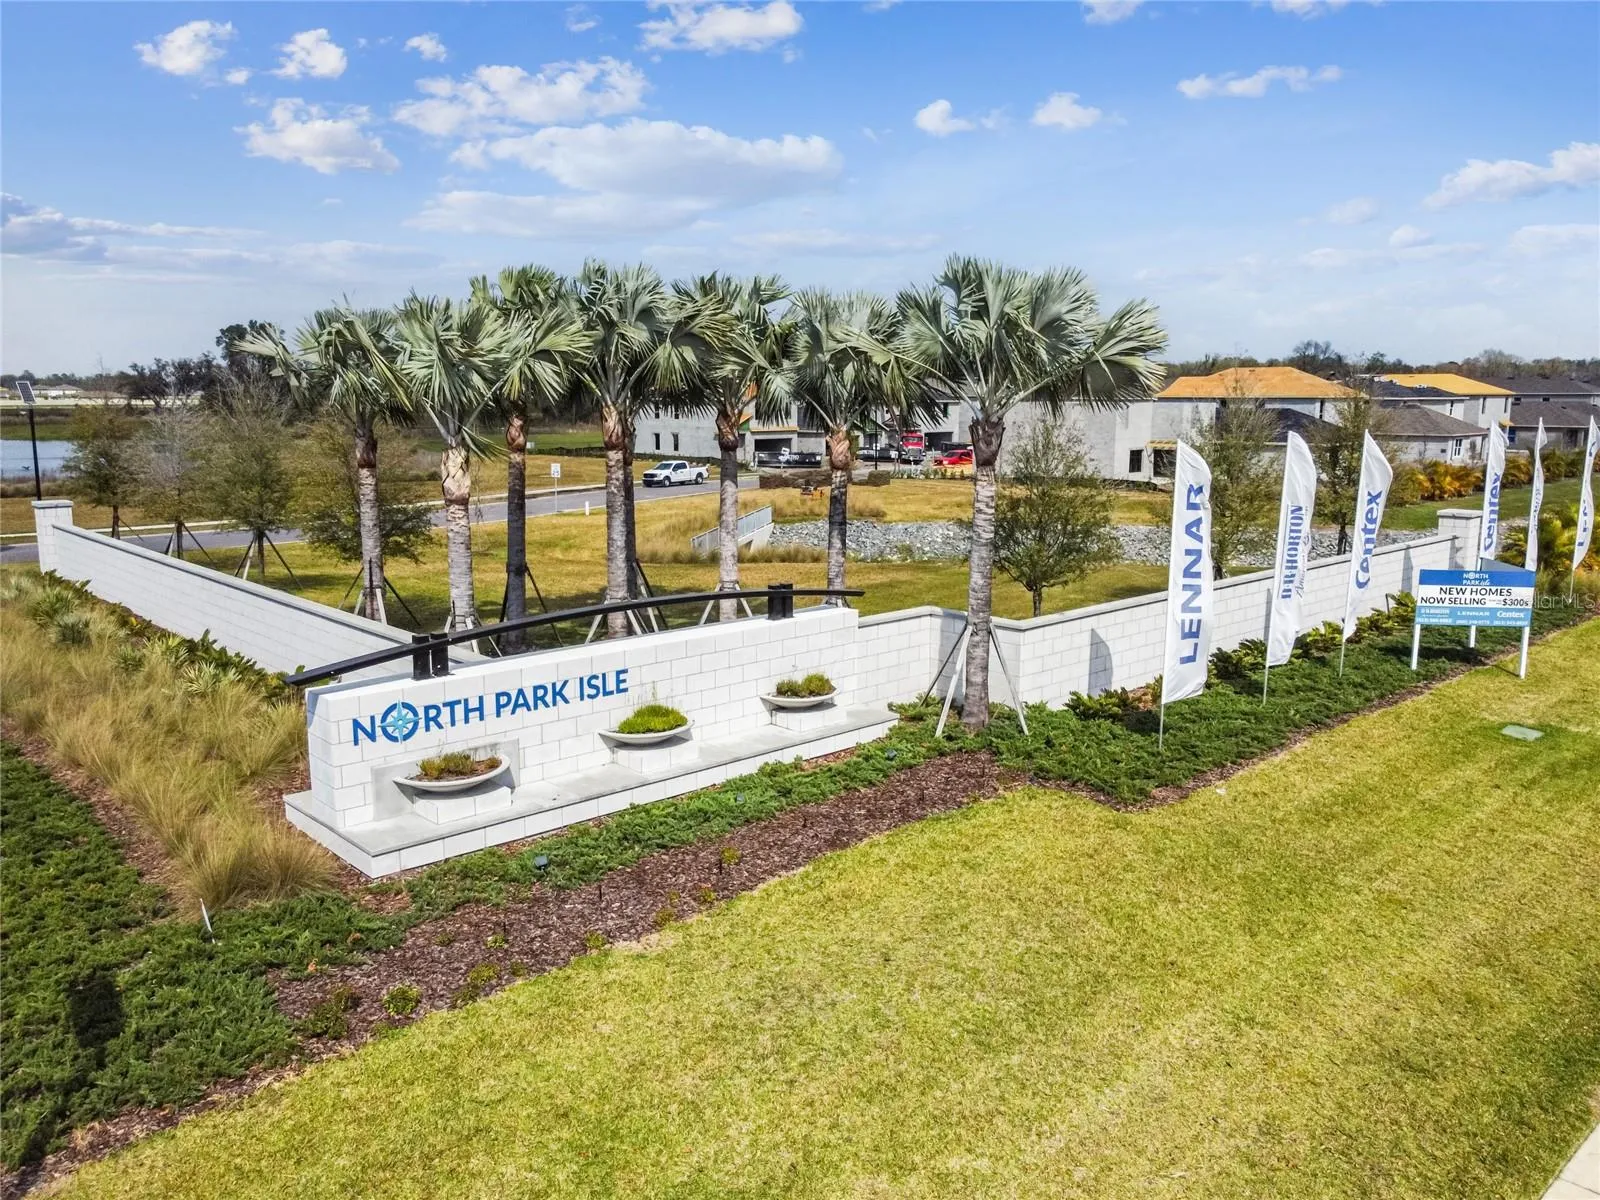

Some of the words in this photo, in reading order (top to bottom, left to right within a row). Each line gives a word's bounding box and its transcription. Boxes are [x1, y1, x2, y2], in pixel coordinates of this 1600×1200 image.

[1355, 490, 1383, 590] Centex
[1179, 482, 1205, 665] LENNAR
[1439, 586, 1467, 596] NEW
[1470, 587, 1512, 597] HOMES
[1420, 596, 1447, 604] NOW
[1448, 597, 1487, 606] SELLING
[1502, 598, 1529, 607] $300s
[1496, 610, 1525, 618] Centex
[352, 695, 485, 746] NORTH
[494, 679, 571, 718] PARK
[578, 668, 629, 702] ISLE
